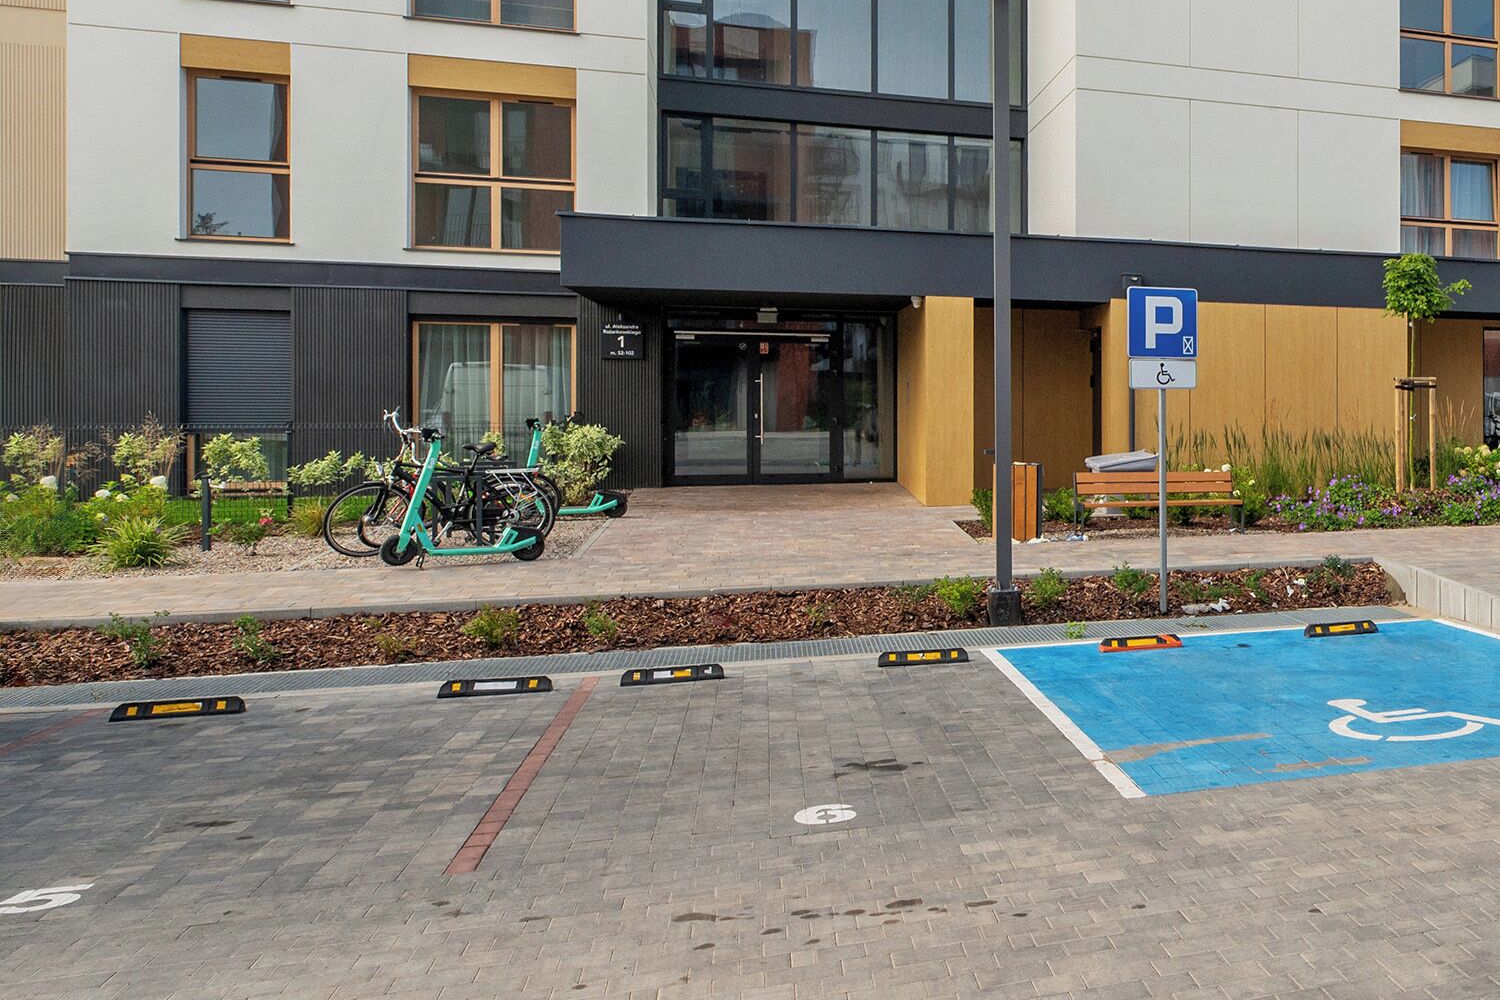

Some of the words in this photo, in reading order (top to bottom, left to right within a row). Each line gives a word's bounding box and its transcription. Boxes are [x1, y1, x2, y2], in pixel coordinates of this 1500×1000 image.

[1145, 296, 1183, 349] P
[617, 335, 624, 348] 1
[794, 804, 857, 825] 6
